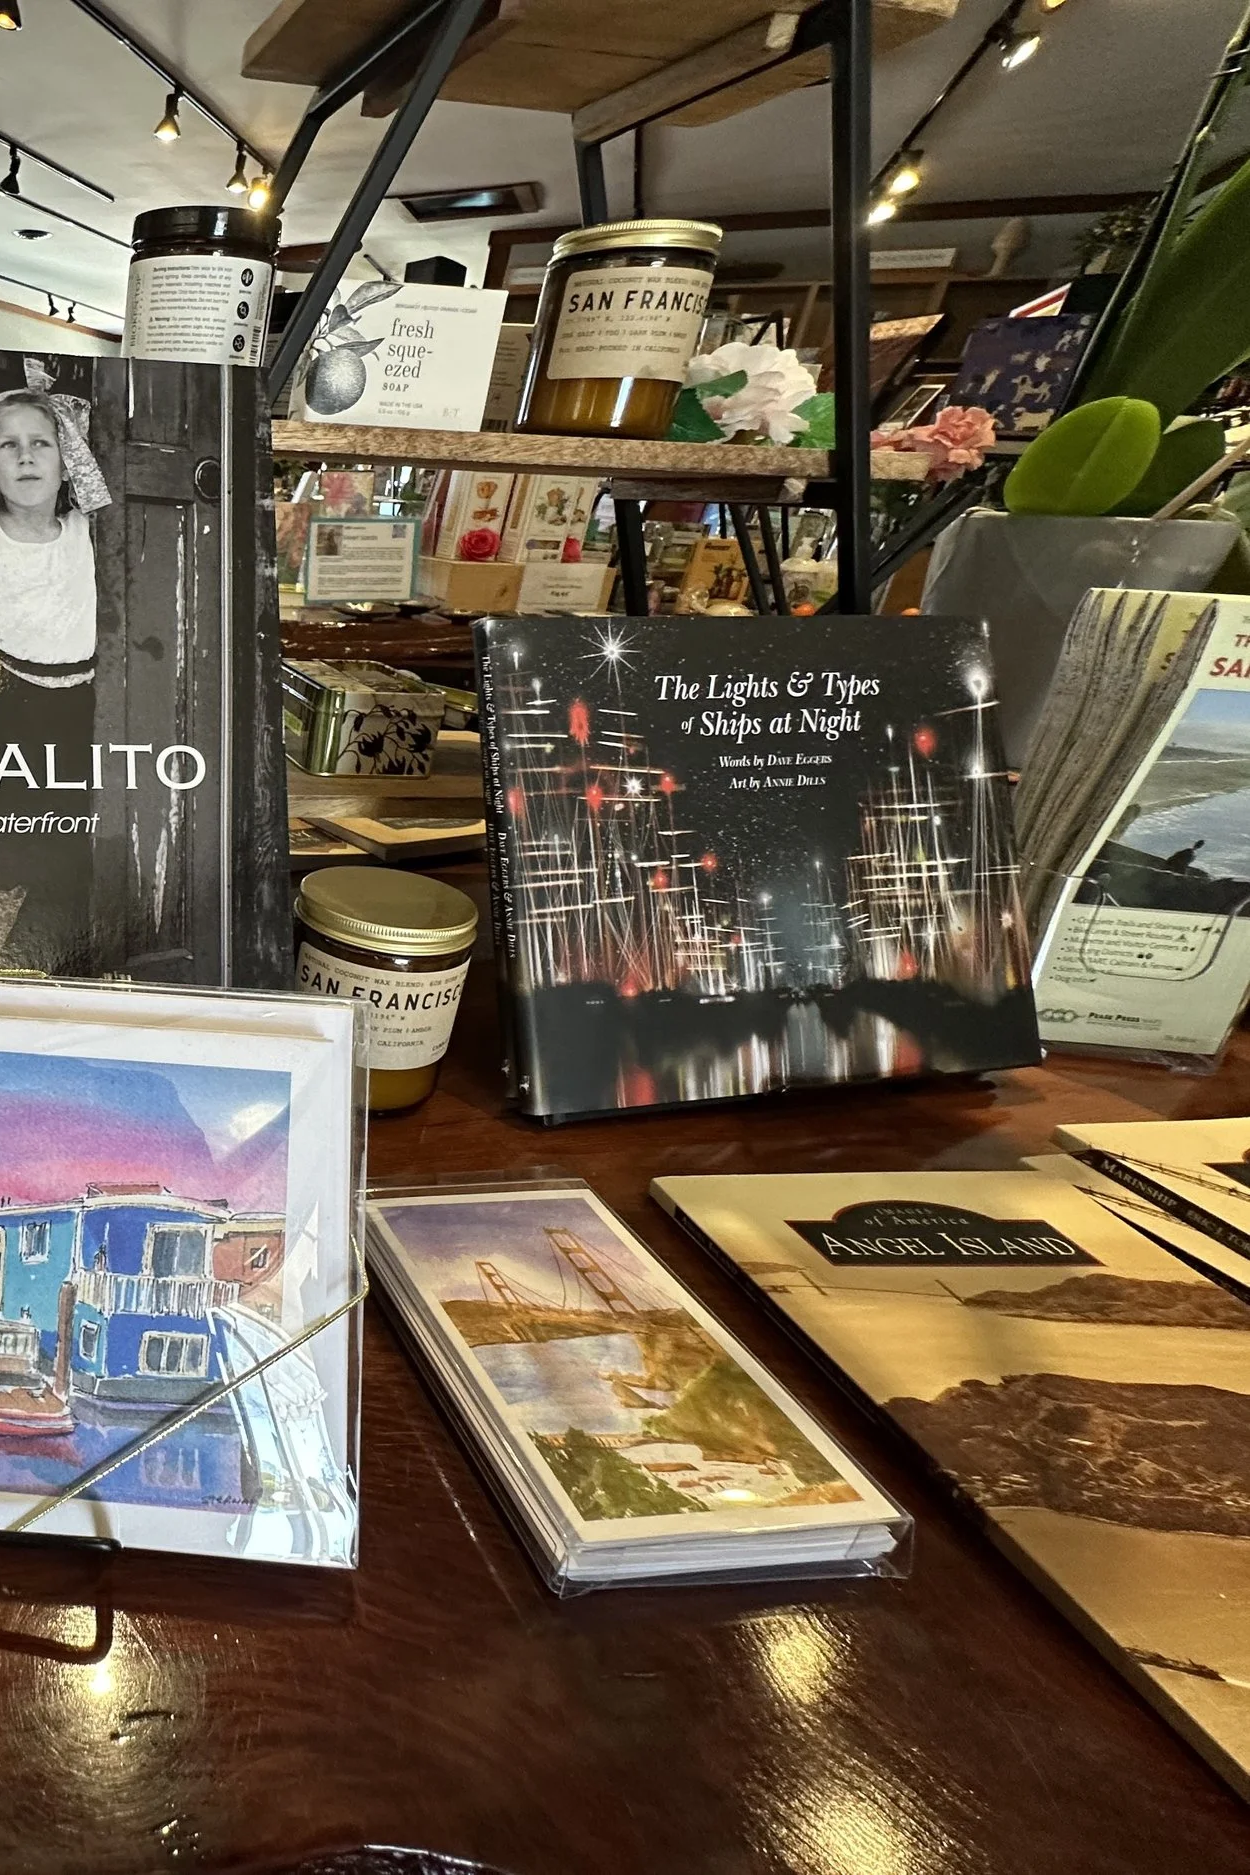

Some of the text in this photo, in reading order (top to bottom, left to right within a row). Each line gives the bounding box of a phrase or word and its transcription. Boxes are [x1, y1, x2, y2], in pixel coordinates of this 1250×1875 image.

[568, 290, 708, 315] SAN FRANCIS
[390, 318, 435, 339] fresh
[387, 343, 434, 363] sque-
[384, 360, 422, 379] ezed
[382, 382, 410, 392] SOAP
[1209, 657, 1250, 678] SA
[654, 671, 881, 707] The Lights & Types
[681, 708, 862, 744] of Ships at Night
[719, 753, 832, 770] Words by DAVE EGGERS
[729, 774, 826, 791] Art by ANNIE DILLS
[334, 967, 371, 983] COCONUT
[374, 979, 390, 987] WAX
[300, 965, 465, 1011] SAN FRANCISC
[1101, 1159, 1178, 1207] MARINSHIP
[864, 1215, 970, 1228] of America
[821, 1232, 1076, 1257] ANGEL ISLAND
